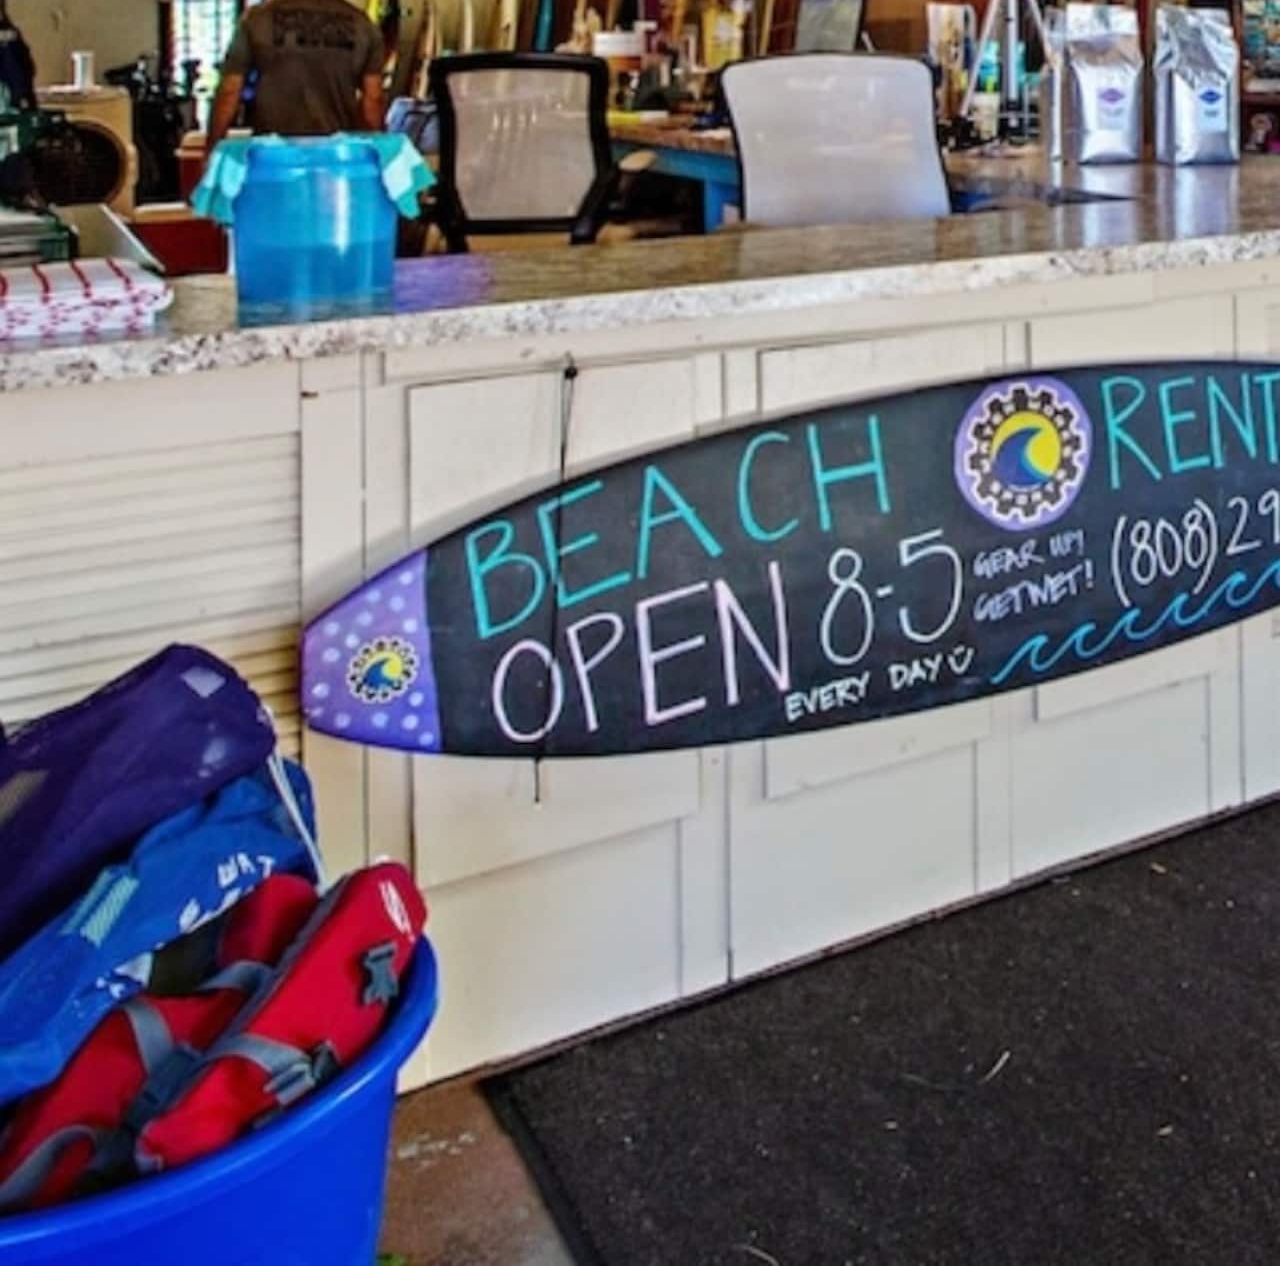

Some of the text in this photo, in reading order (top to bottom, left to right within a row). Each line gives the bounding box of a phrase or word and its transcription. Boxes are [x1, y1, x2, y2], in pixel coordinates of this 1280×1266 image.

[464, 415, 890, 639] BEACH
[973, 539, 1045, 579] GEAR
[1112, 498, 1217, 608] (808)
[492, 529, 962, 744] OPEN 8-5
[785, 653, 942, 723] EVERY DAY
